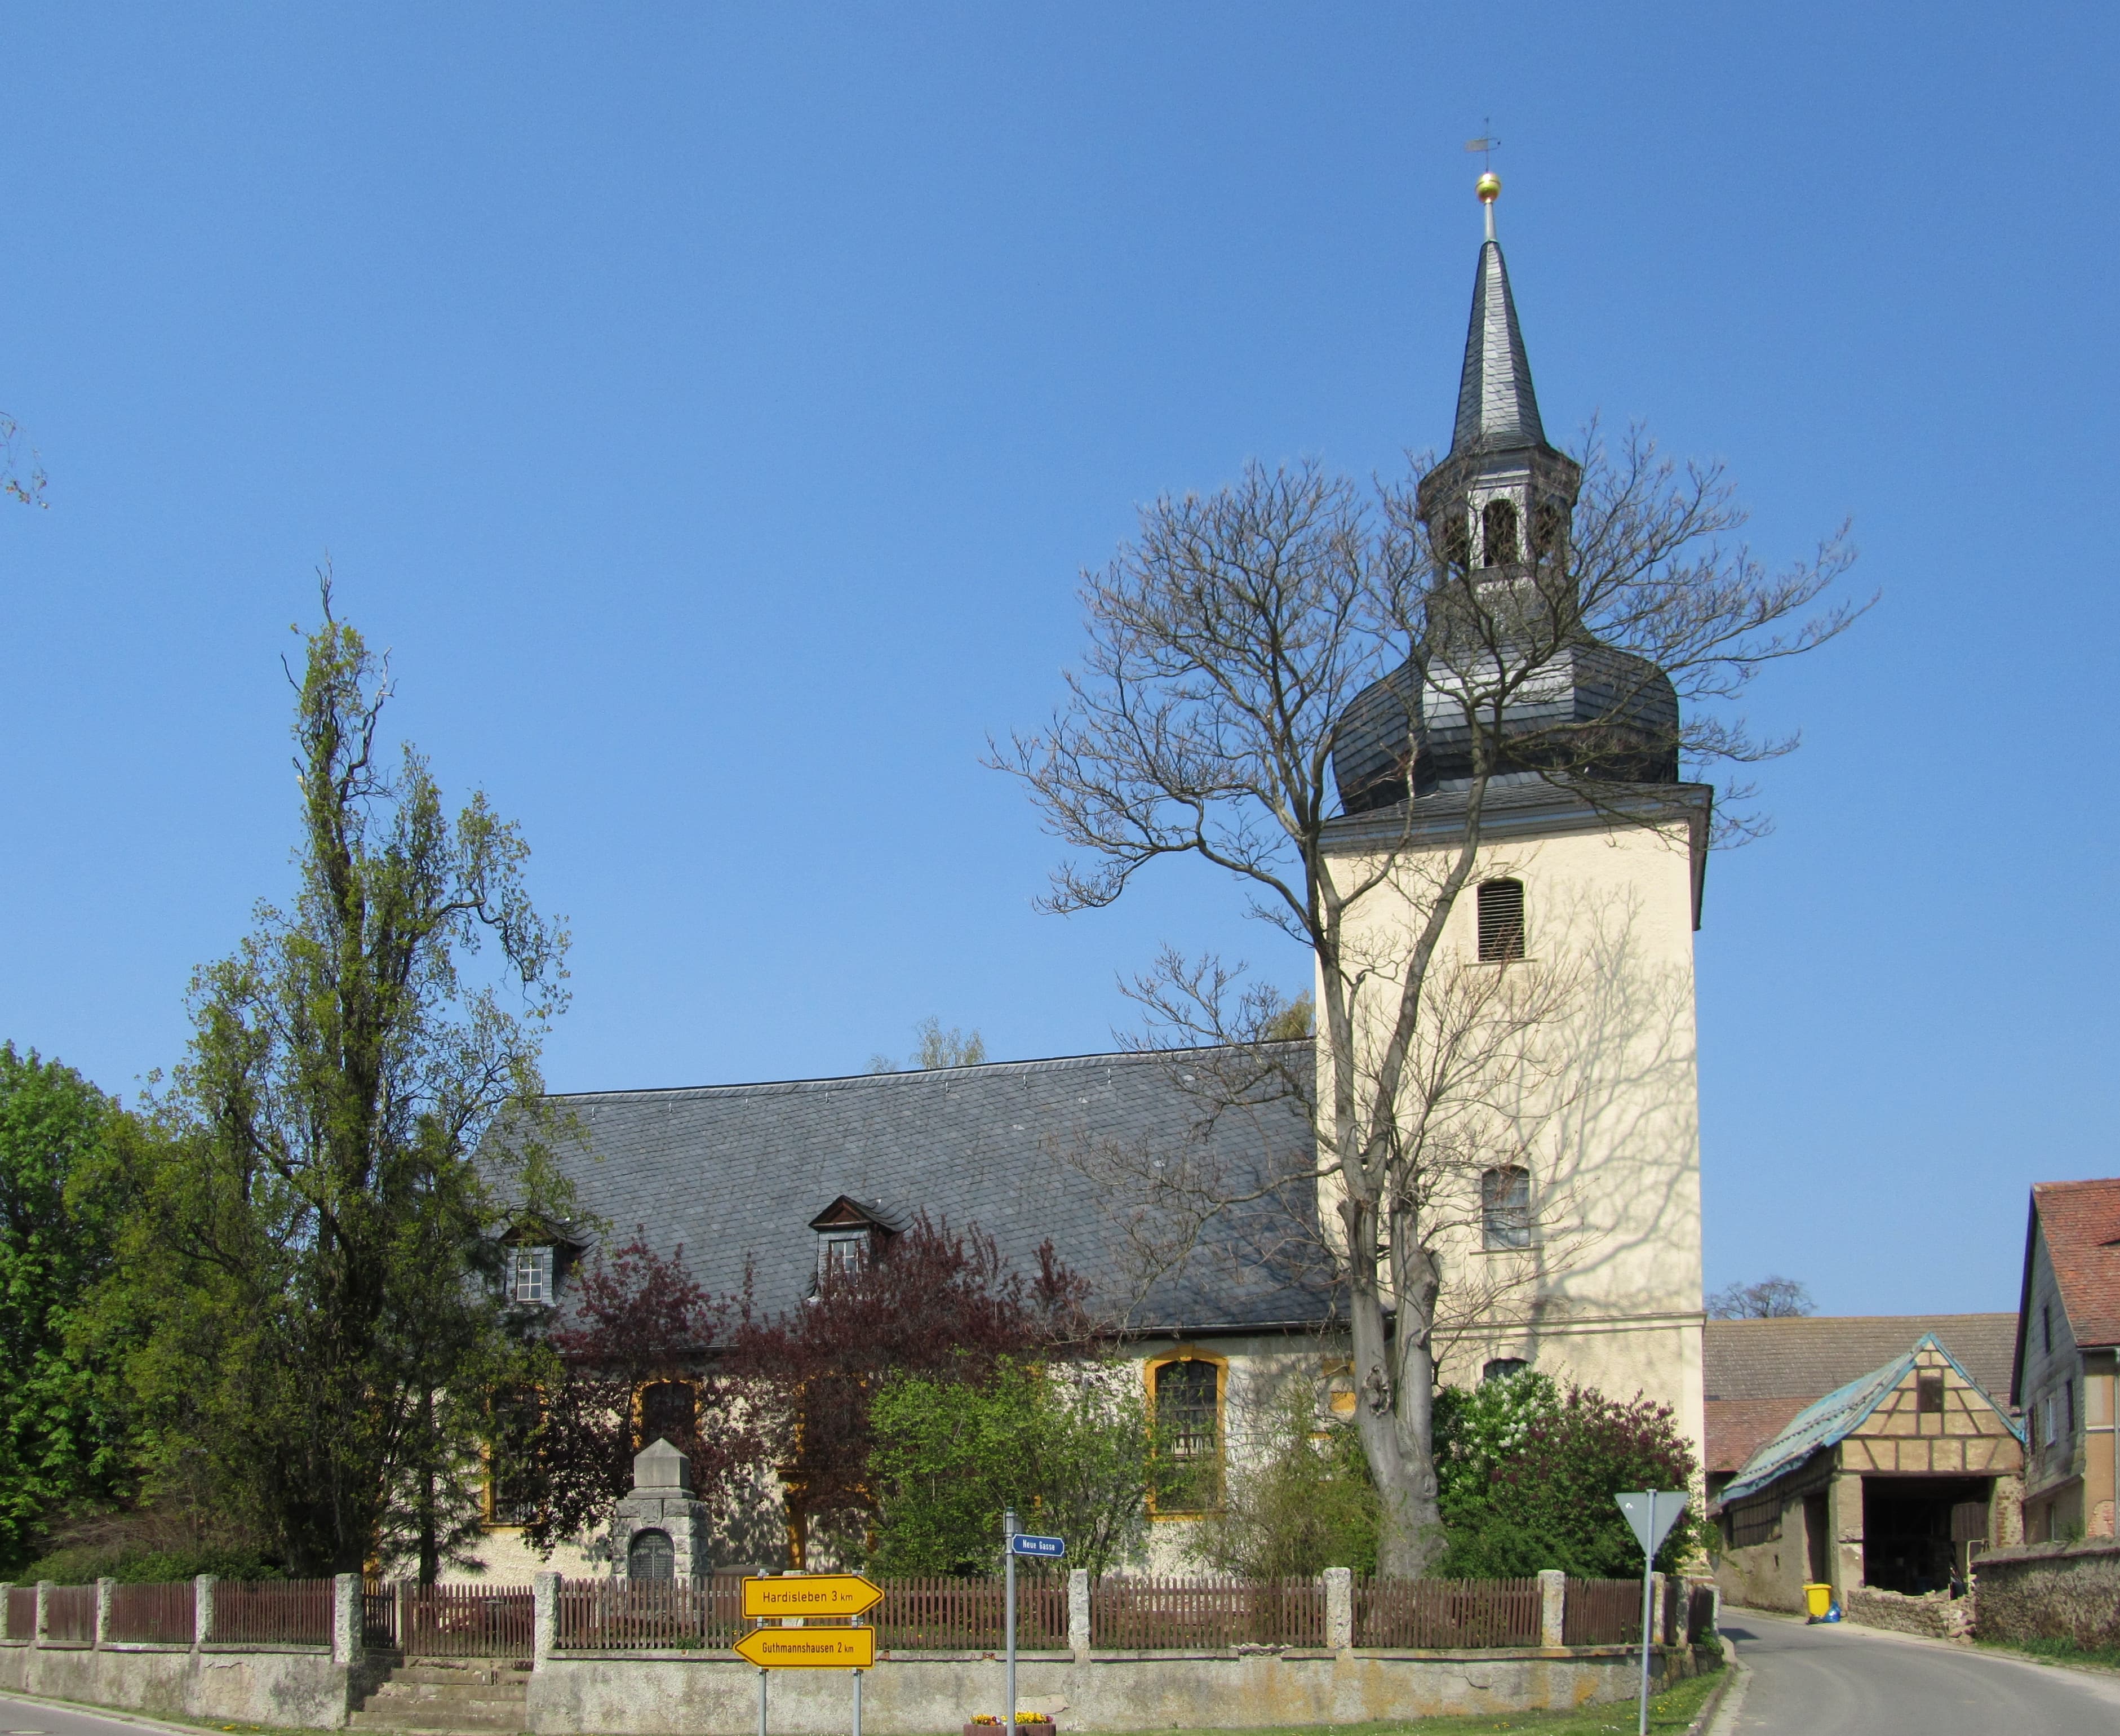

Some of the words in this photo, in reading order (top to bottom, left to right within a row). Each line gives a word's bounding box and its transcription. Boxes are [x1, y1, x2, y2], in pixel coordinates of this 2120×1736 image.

[1023, 1539, 1036, 1549] Neue
[1039, 1541, 1055, 1551] Gasse
[763, 1591, 827, 1602] Hardisleben
[832, 1591, 837, 1602] 3
[841, 1592, 853, 1601] km
[762, 1642, 833, 1653] Guthmannshausen
[837, 1642, 842, 1653] 2
